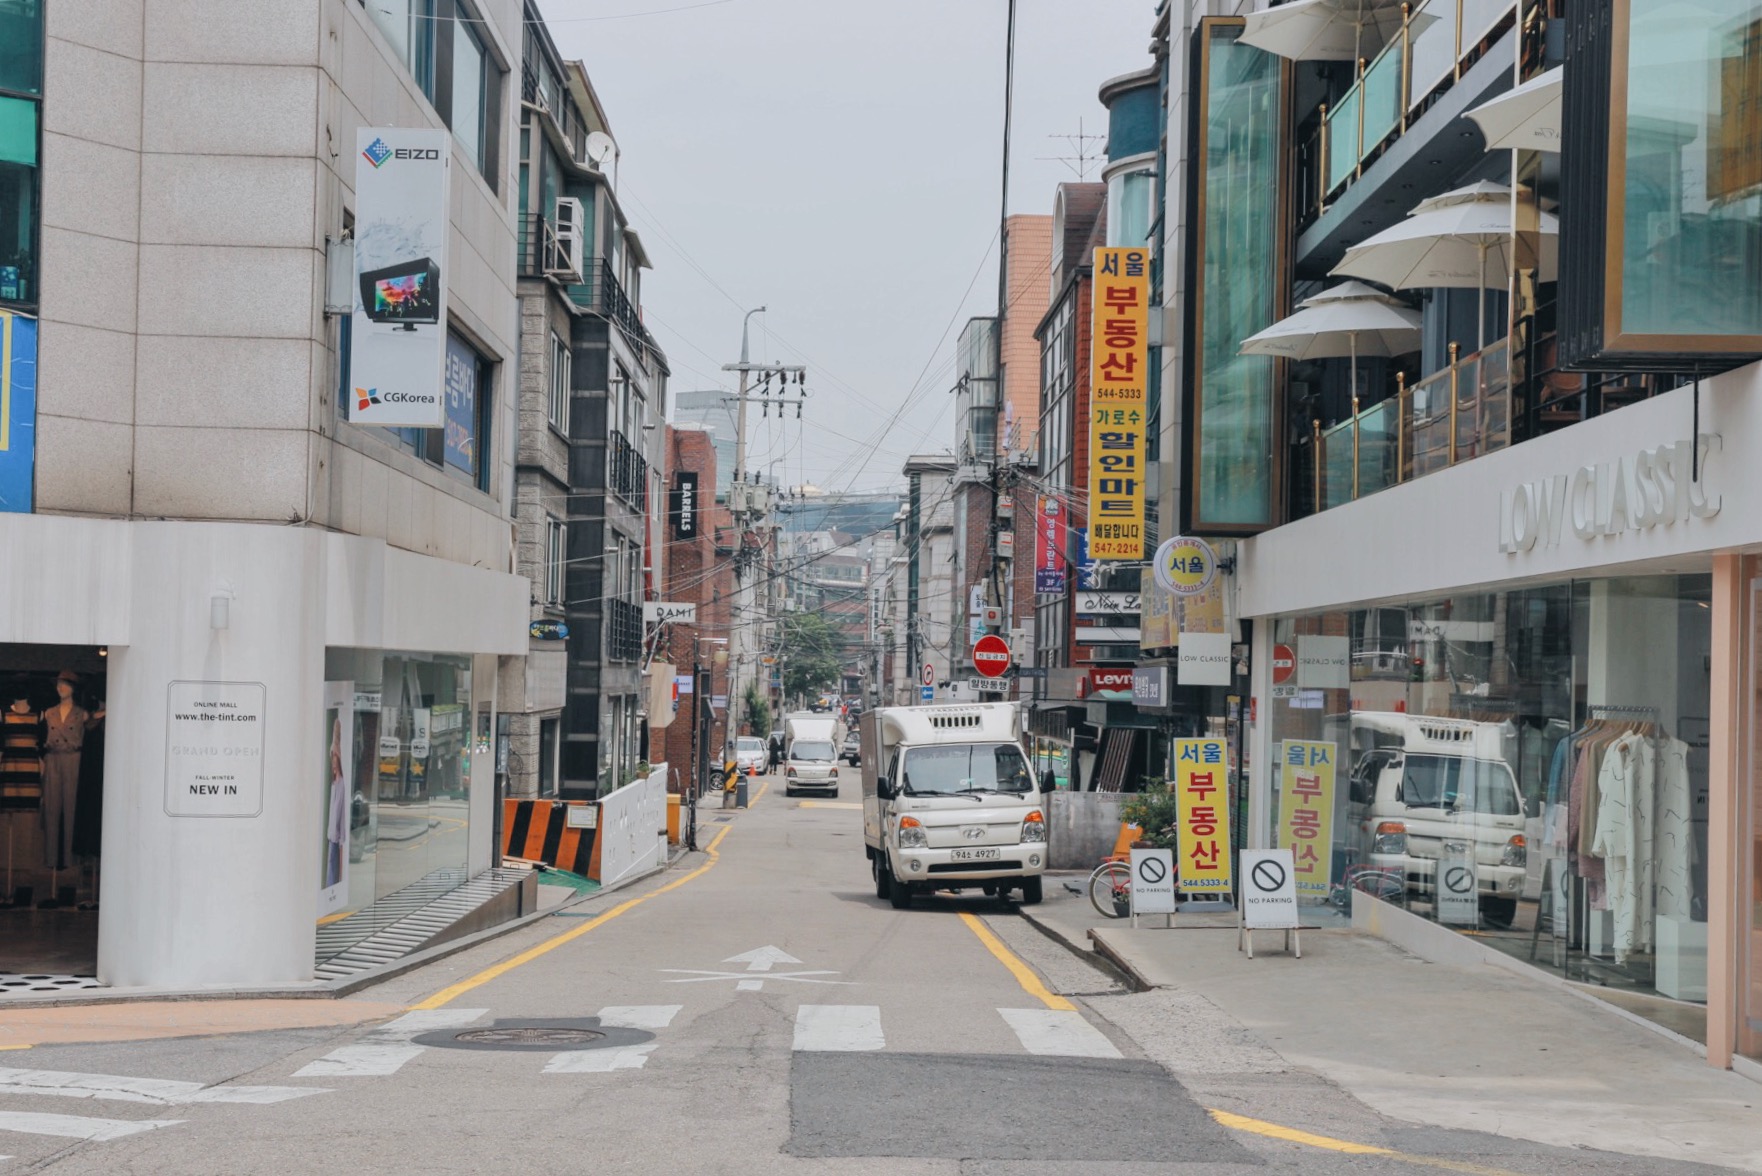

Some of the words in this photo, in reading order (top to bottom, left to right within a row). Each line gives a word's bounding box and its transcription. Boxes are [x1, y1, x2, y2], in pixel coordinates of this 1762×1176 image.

[395, 148, 439, 160] EIZO
[1100, 252, 1144, 277] 서울
[1099, 286, 1138, 382] 부동산
[384, 391, 436, 404] CGKorea
[1098, 388, 1142, 399] 544-5333
[1096, 410, 1140, 426] 가로수
[1098, 432, 1138, 517] 할인마트
[1499, 474, 1568, 554] LOW
[1572, 433, 1722, 540] CLASSIC
[680, 482, 692, 532] BARRELS
[1094, 524, 1139, 538] 배달합니다
[1094, 542, 1139, 554] 547-2214
[1170, 556, 1204, 574] 서울
[656, 607, 691, 618] DAMI
[971, 680, 1008, 690] 일방통행
[175, 712, 256, 722] www.the-tint.com
[172, 744, 218, 756] GRAND
[223, 746, 260, 756] OPEN
[1180, 743, 1222, 764] 서울
[190, 785, 219, 795] NEW
[224, 785, 237, 795] IN
[1187, 772, 1220, 870] 부동산
[975, 850, 996, 858] 4927
